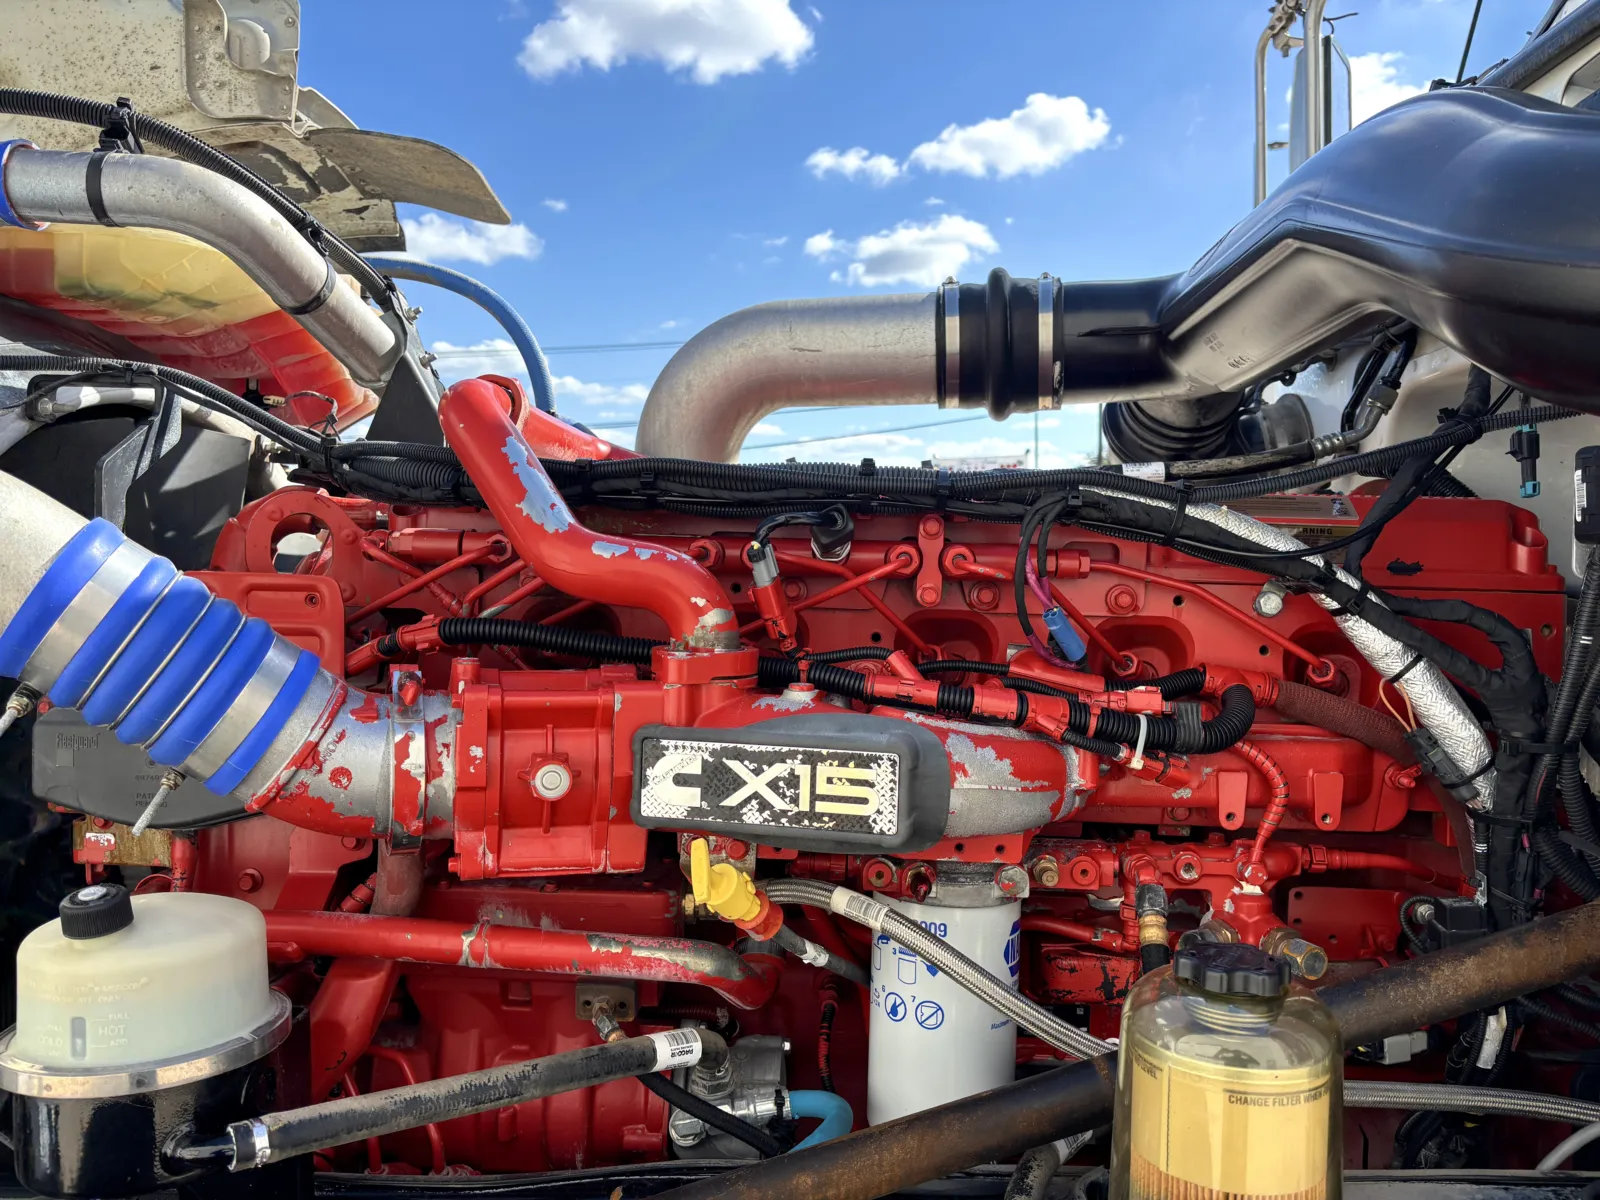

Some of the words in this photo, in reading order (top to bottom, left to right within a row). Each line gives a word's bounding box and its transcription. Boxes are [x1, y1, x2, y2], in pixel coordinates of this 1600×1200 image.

[1301, 527, 1333, 536] RNING
[136, 792, 169, 800] PATT
[892, 947, 897, 955] 3
[98, 1024, 126, 1036] HOT
[1228, 1094, 1270, 1107] CHANGE
[1272, 1095, 1302, 1107] FILTER
